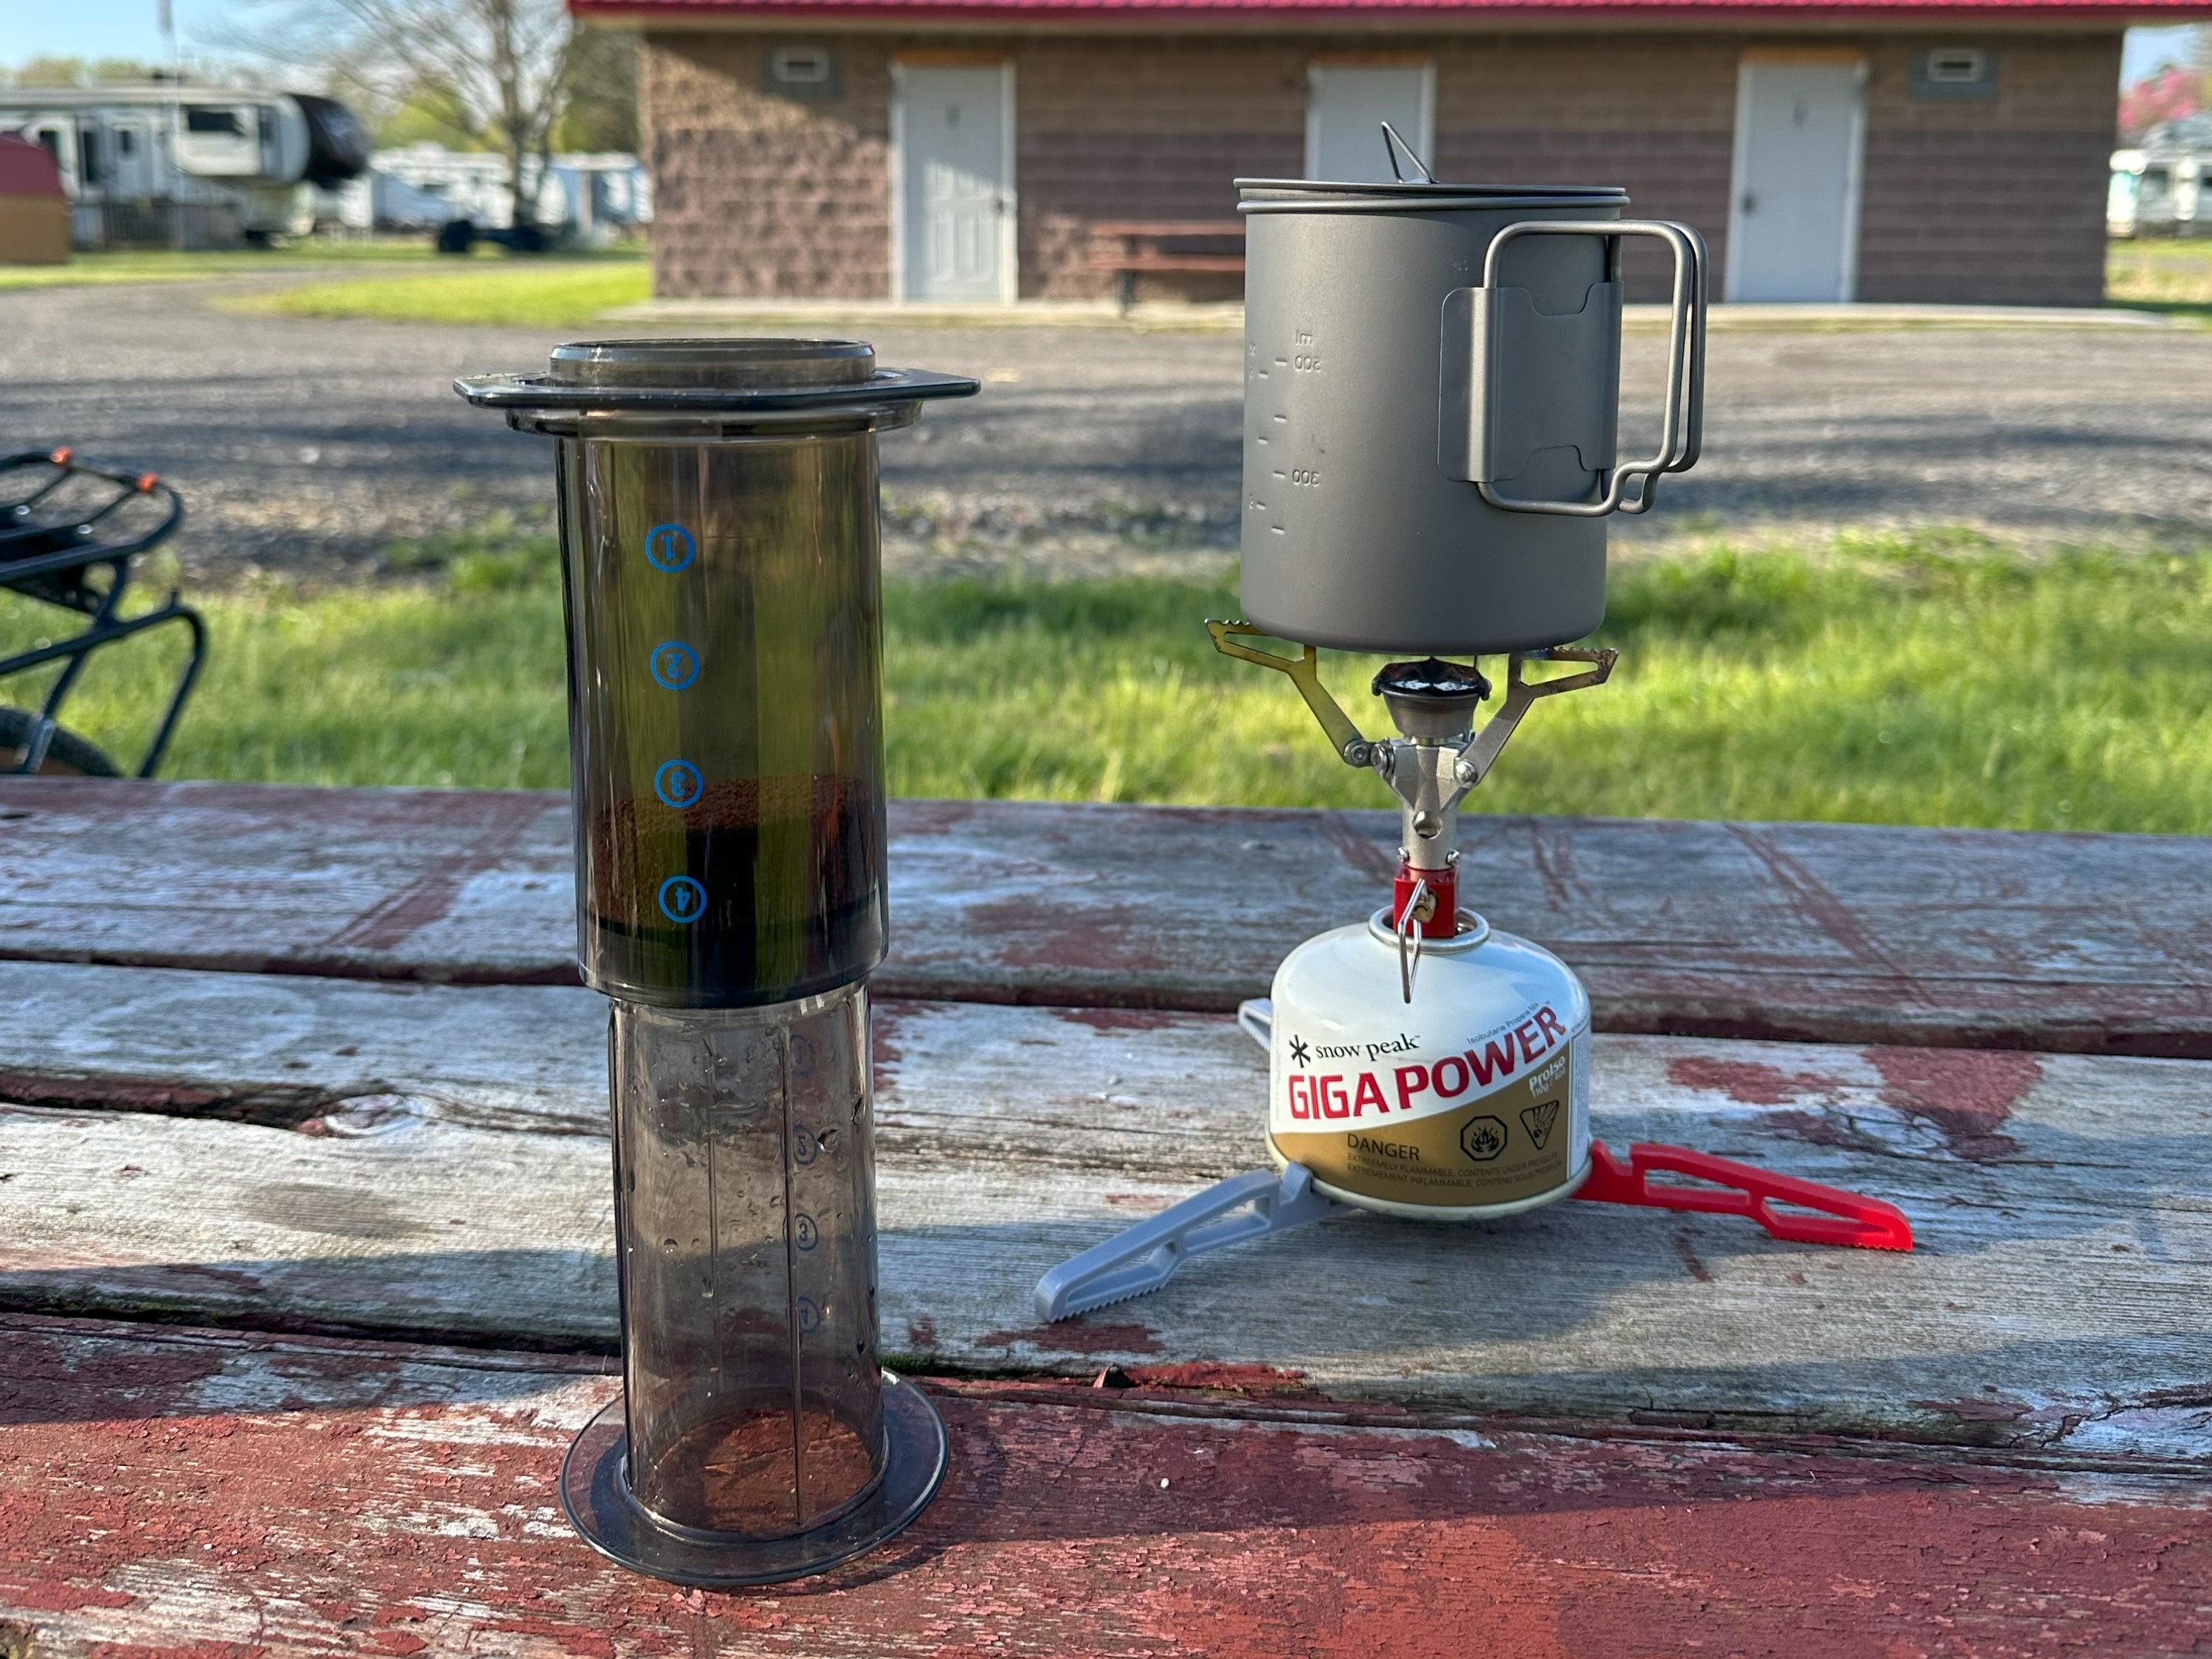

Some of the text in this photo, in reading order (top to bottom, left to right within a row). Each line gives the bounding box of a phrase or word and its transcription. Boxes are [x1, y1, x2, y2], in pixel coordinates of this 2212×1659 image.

[1466, 1025, 1507, 1045] Isobutane
[1315, 1045, 1361, 1059] snow
[1529, 1056, 1565, 1092] ProIso
[1289, 1072, 1391, 1119] GIGA
[1347, 1132, 1420, 1161] DANGER
